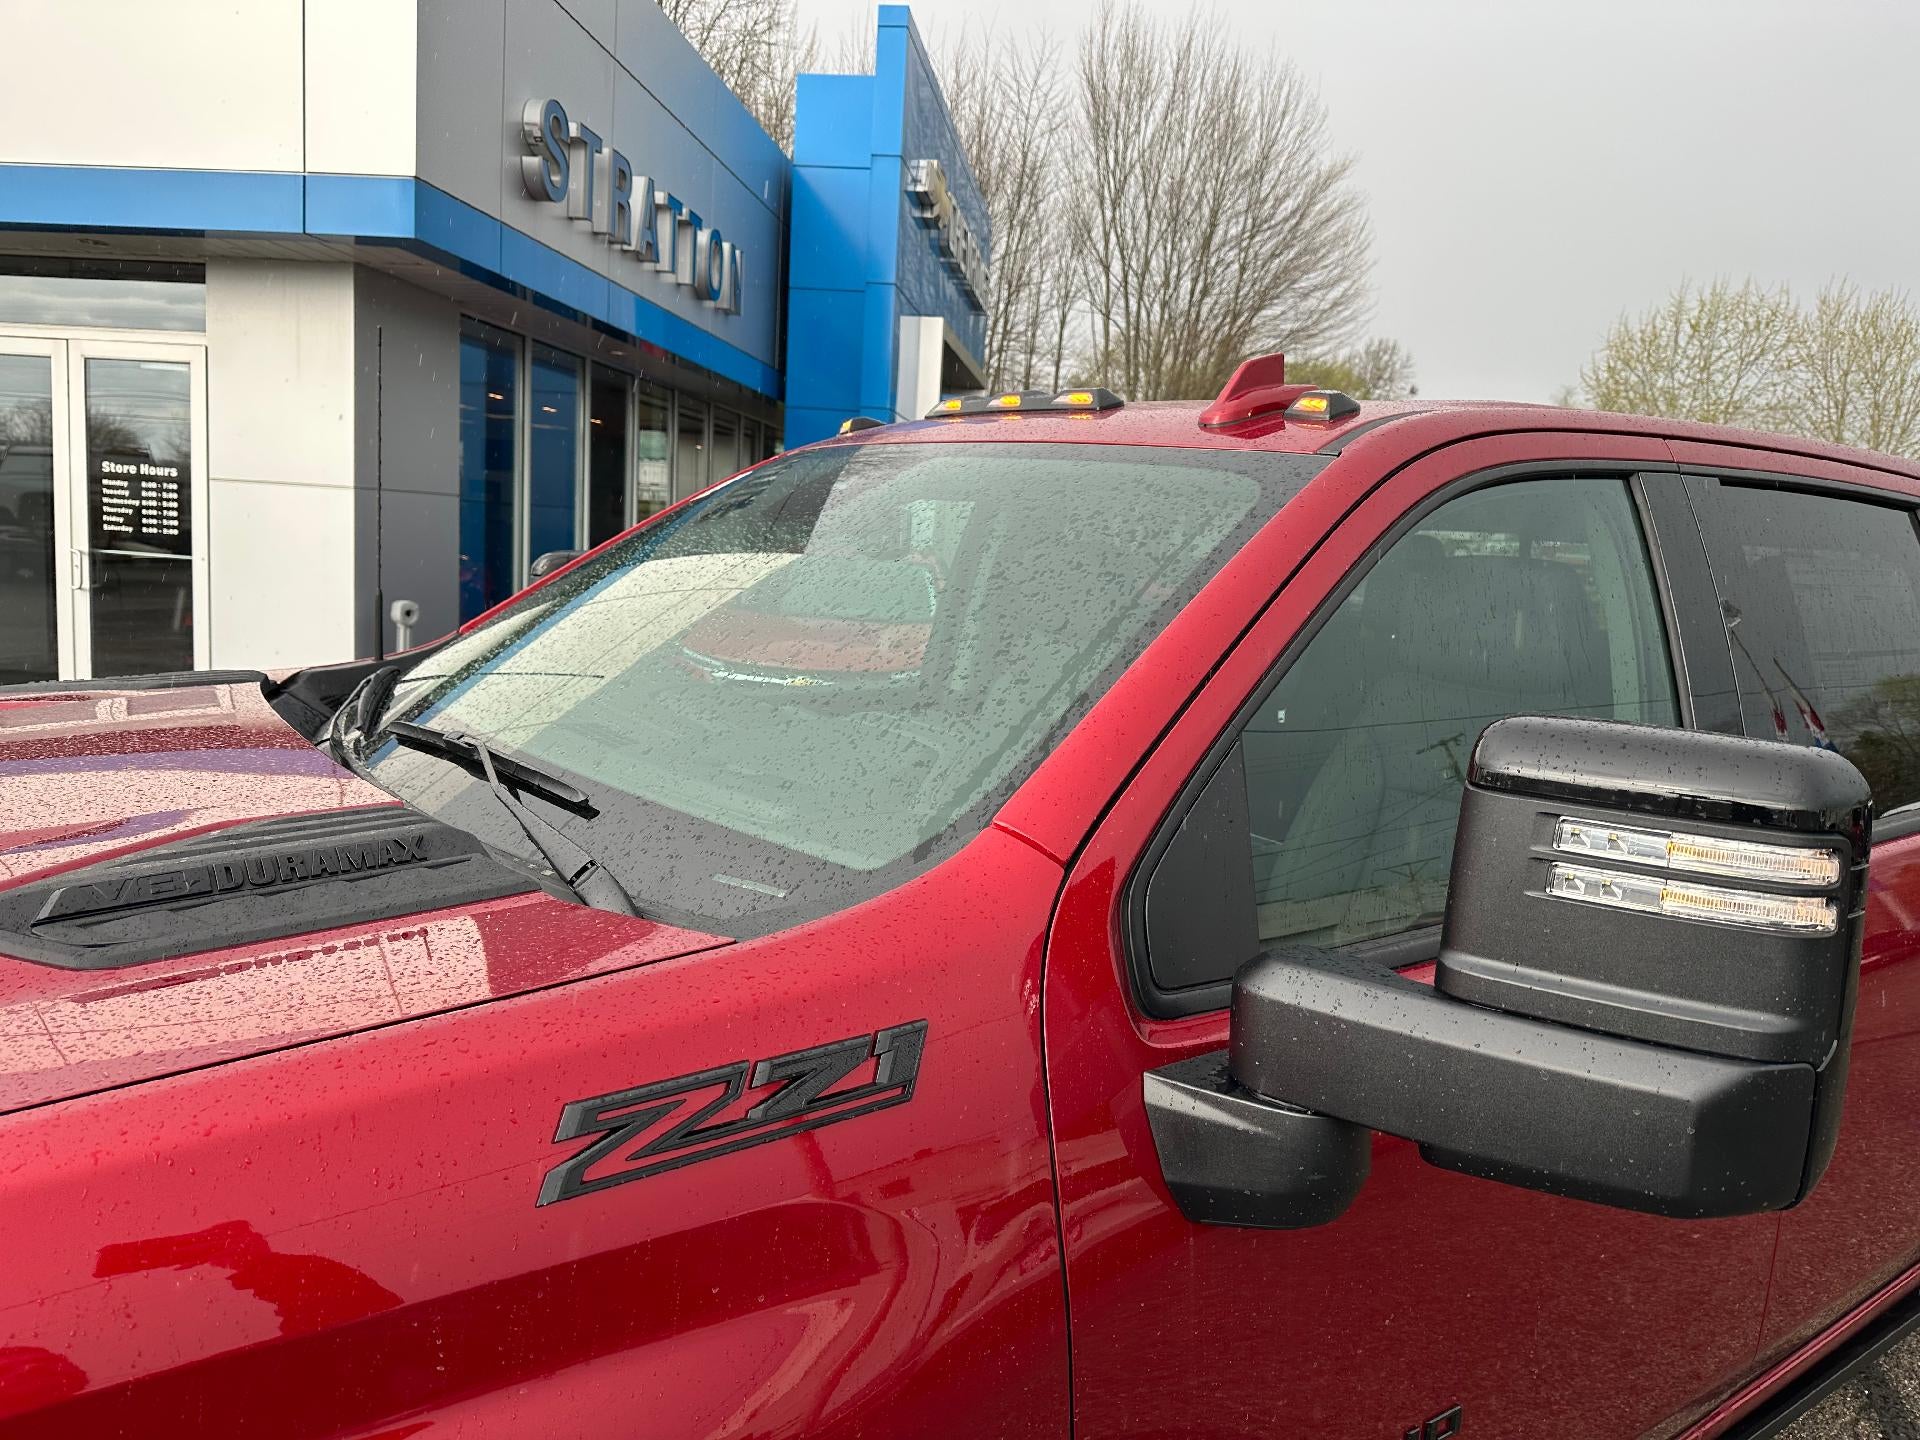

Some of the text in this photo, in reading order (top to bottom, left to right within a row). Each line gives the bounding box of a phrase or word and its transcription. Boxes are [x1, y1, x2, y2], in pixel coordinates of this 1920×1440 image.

[520, 98, 744, 316] STRATTON
[102, 461, 178, 477] Store Hours
[102, 478, 129, 488] Monday
[102, 488, 130, 497] Tuesday
[102, 496, 140, 507] Wednesday
[102, 506, 133, 515] Thursday
[102, 514, 124, 524] Friday
[102, 524, 134, 533] Saturday
[213, 833, 429, 893] DURAMAX
[536, 1018, 929, 1208] Z71
